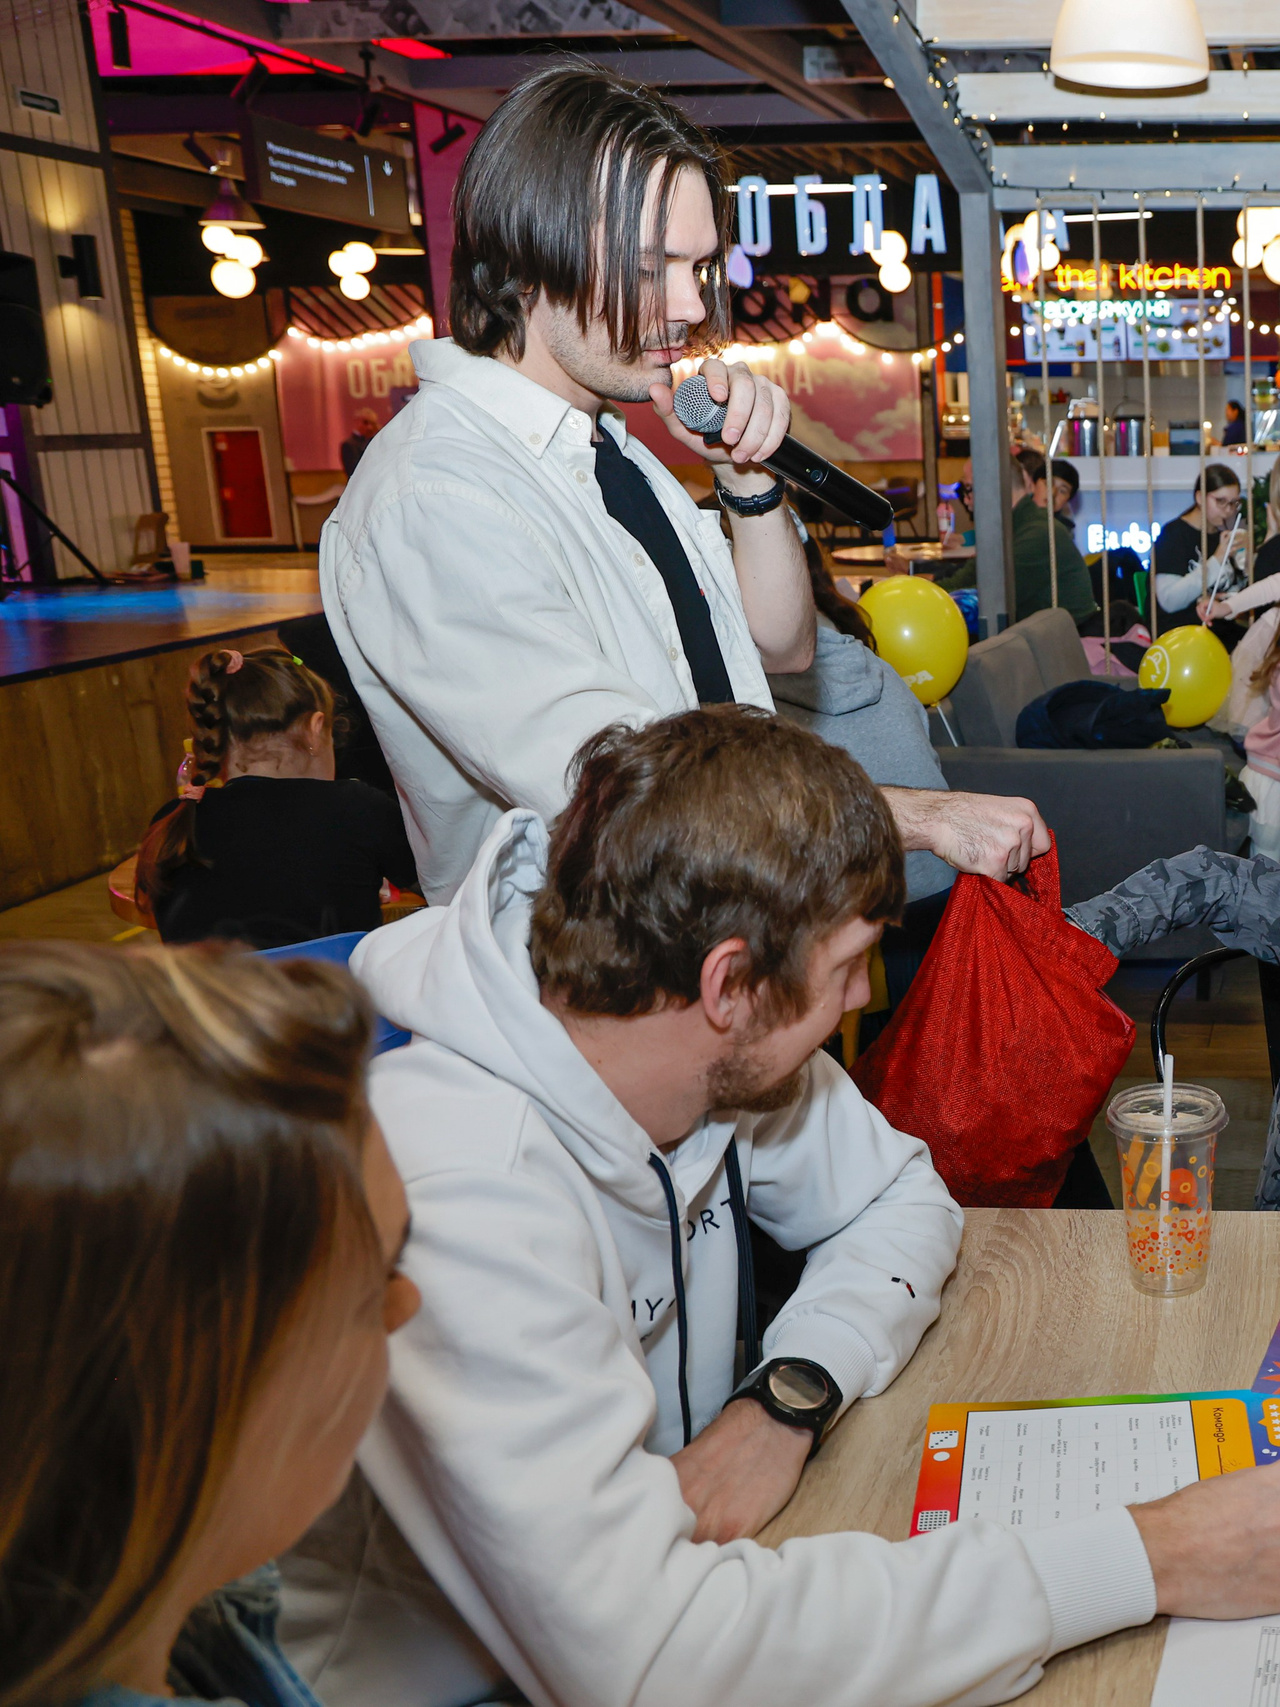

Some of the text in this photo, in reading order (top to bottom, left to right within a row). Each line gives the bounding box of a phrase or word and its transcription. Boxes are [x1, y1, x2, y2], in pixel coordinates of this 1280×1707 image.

[1056, 263, 1109, 291] thai
[1118, 262, 1232, 290] kitchen
[1213, 1407, 1225, 1443] Команда
